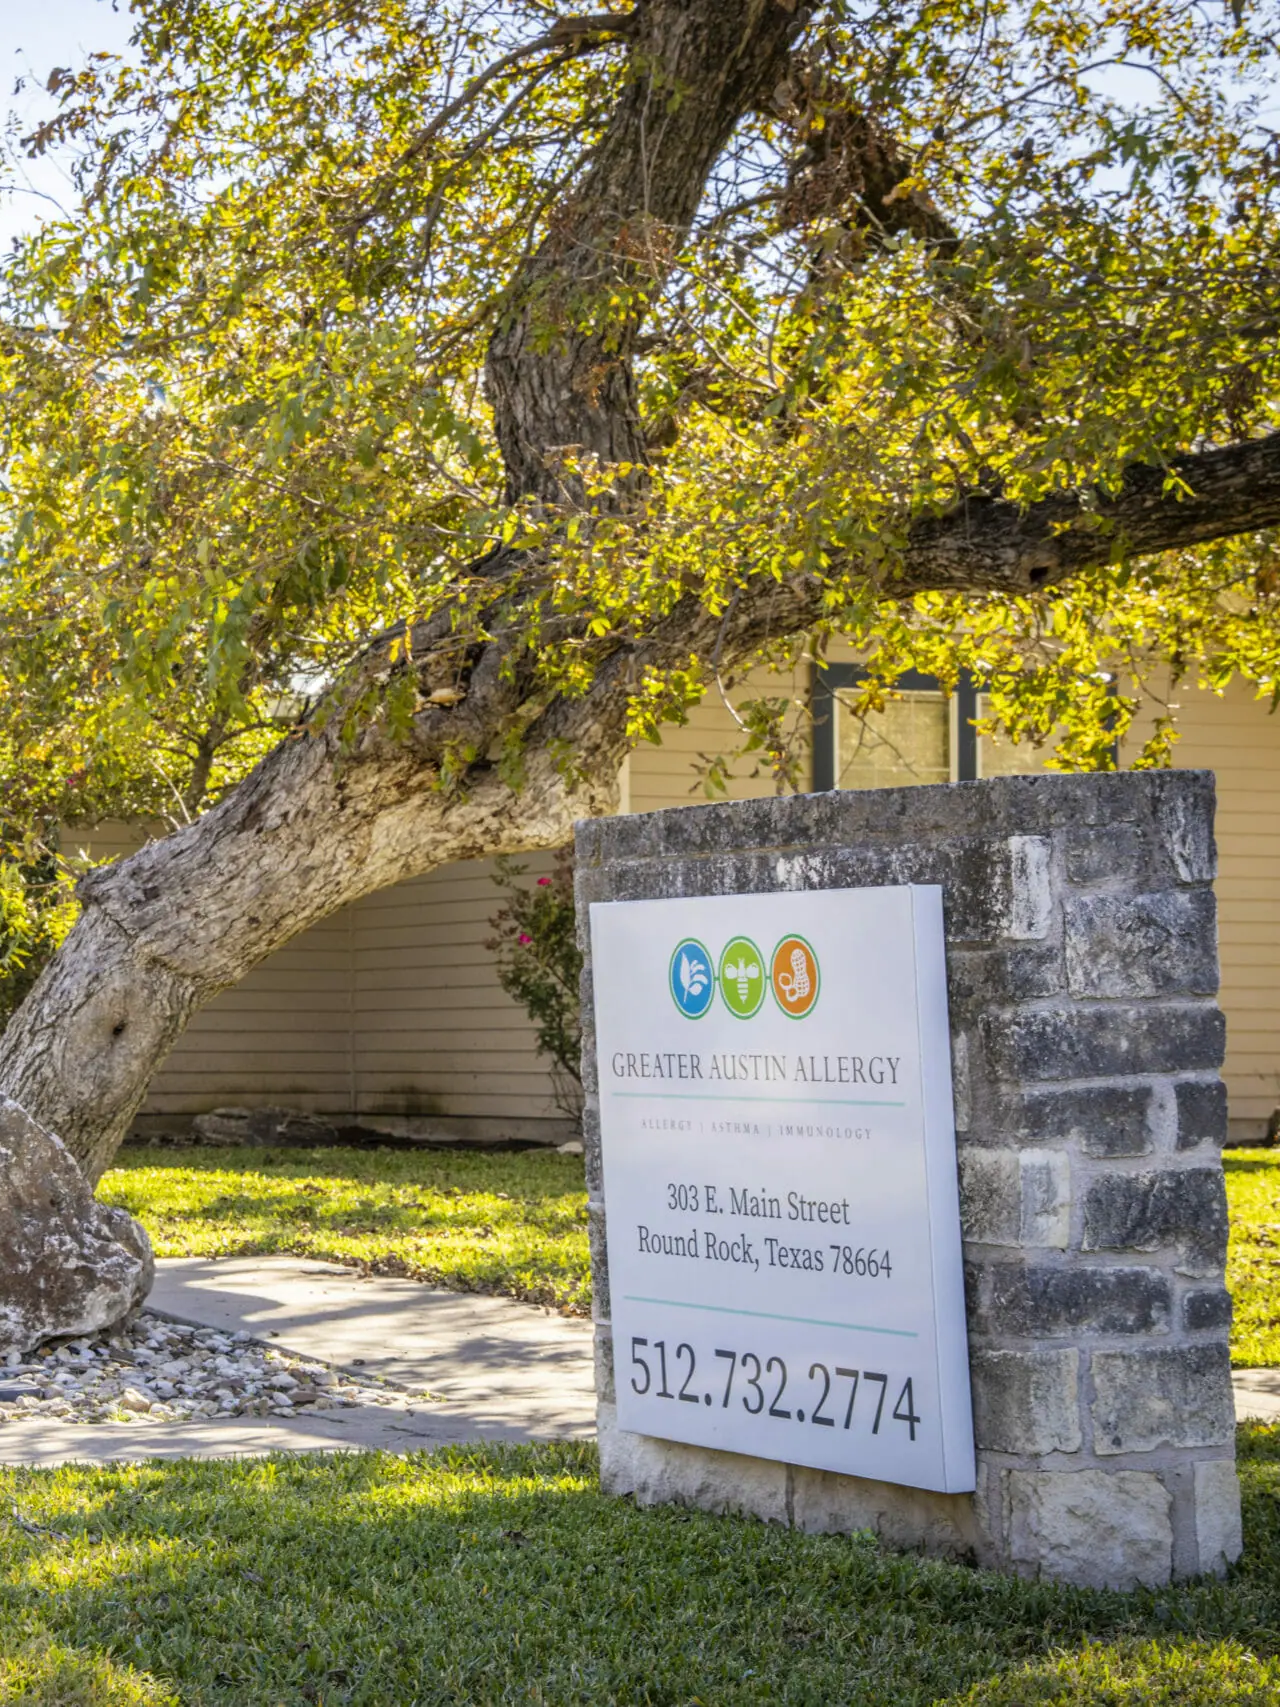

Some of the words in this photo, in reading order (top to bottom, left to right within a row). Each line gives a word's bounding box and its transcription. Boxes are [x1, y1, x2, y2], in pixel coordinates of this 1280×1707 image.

[612, 1052, 704, 1079] GREATER
[709, 1054, 787, 1081] AUSTIN
[794, 1056, 901, 1085] ALLERGY
[641, 1118, 693, 1132] ALLERGY
[711, 1122, 761, 1136] ASTHMA
[779, 1125, 873, 1141] IMMUNOLOGY
[667, 1183, 700, 1212] 303
[704, 1185, 724, 1214] E.
[729, 1187, 783, 1219] Main
[787, 1191, 851, 1225] Street
[637, 1225, 700, 1259] Round
[704, 1231, 760, 1273] Rock,
[764, 1237, 825, 1273] Texas
[830, 1245, 893, 1279] 78664
[631, 1335, 921, 1442] 512.732.2774
